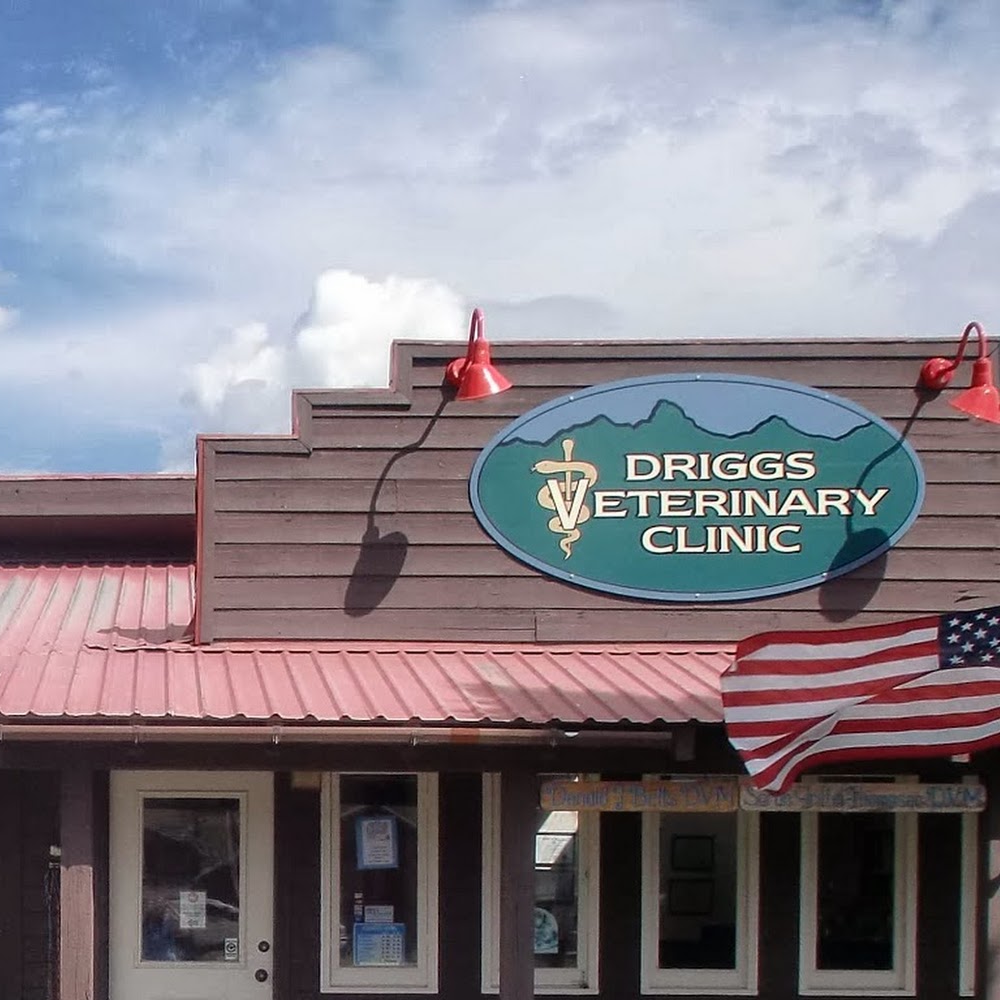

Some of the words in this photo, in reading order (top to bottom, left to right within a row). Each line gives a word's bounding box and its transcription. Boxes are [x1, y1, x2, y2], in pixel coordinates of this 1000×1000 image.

[624, 451, 816, 482] DRIGGS
[546, 479, 890, 531] VETERINARY
[641, 524, 802, 554] CLINIC
